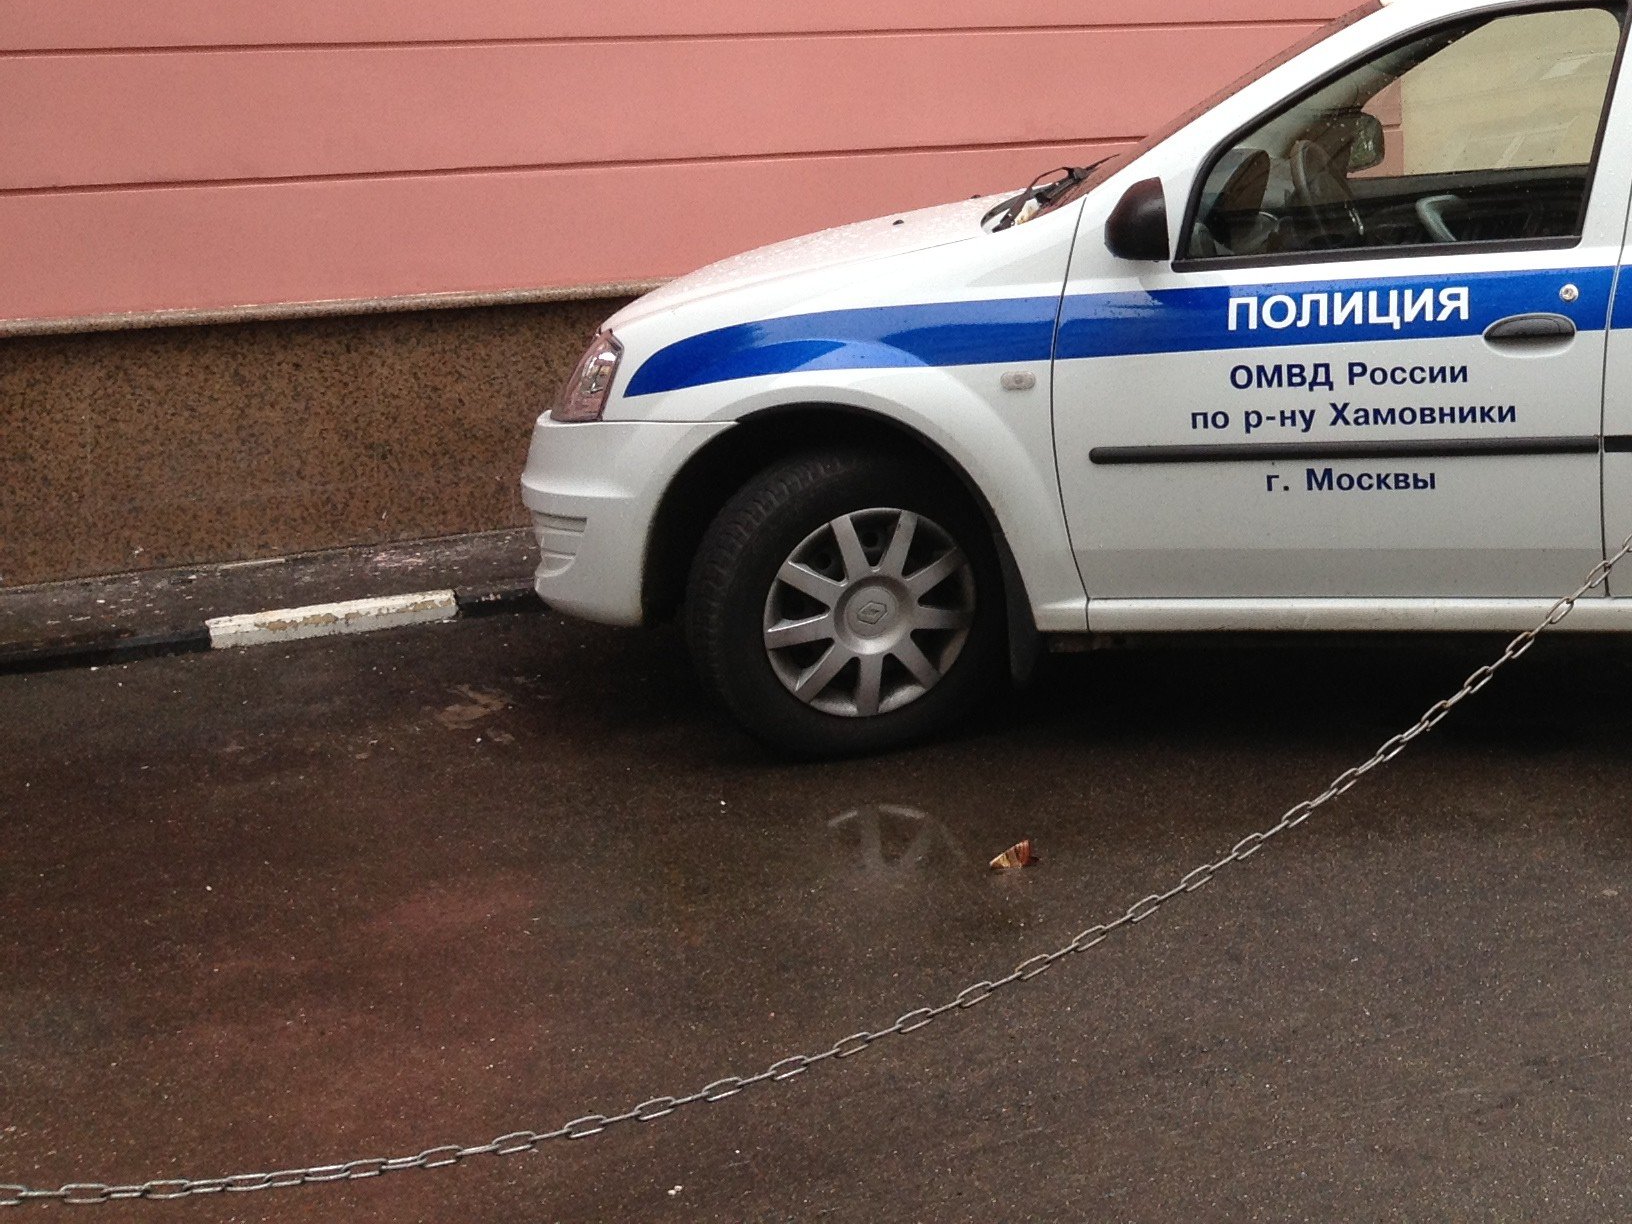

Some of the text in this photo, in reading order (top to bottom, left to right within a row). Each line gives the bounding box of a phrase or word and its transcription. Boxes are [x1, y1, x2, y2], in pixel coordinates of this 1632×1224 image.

[1227, 286, 1469, 330] ПОЛИЦИЯ
[1229, 362, 1469, 391] ОМВД России
[1190, 401, 1517, 434] по р-ну Хамовники
[1266, 468, 1436, 492] г. Москвы
